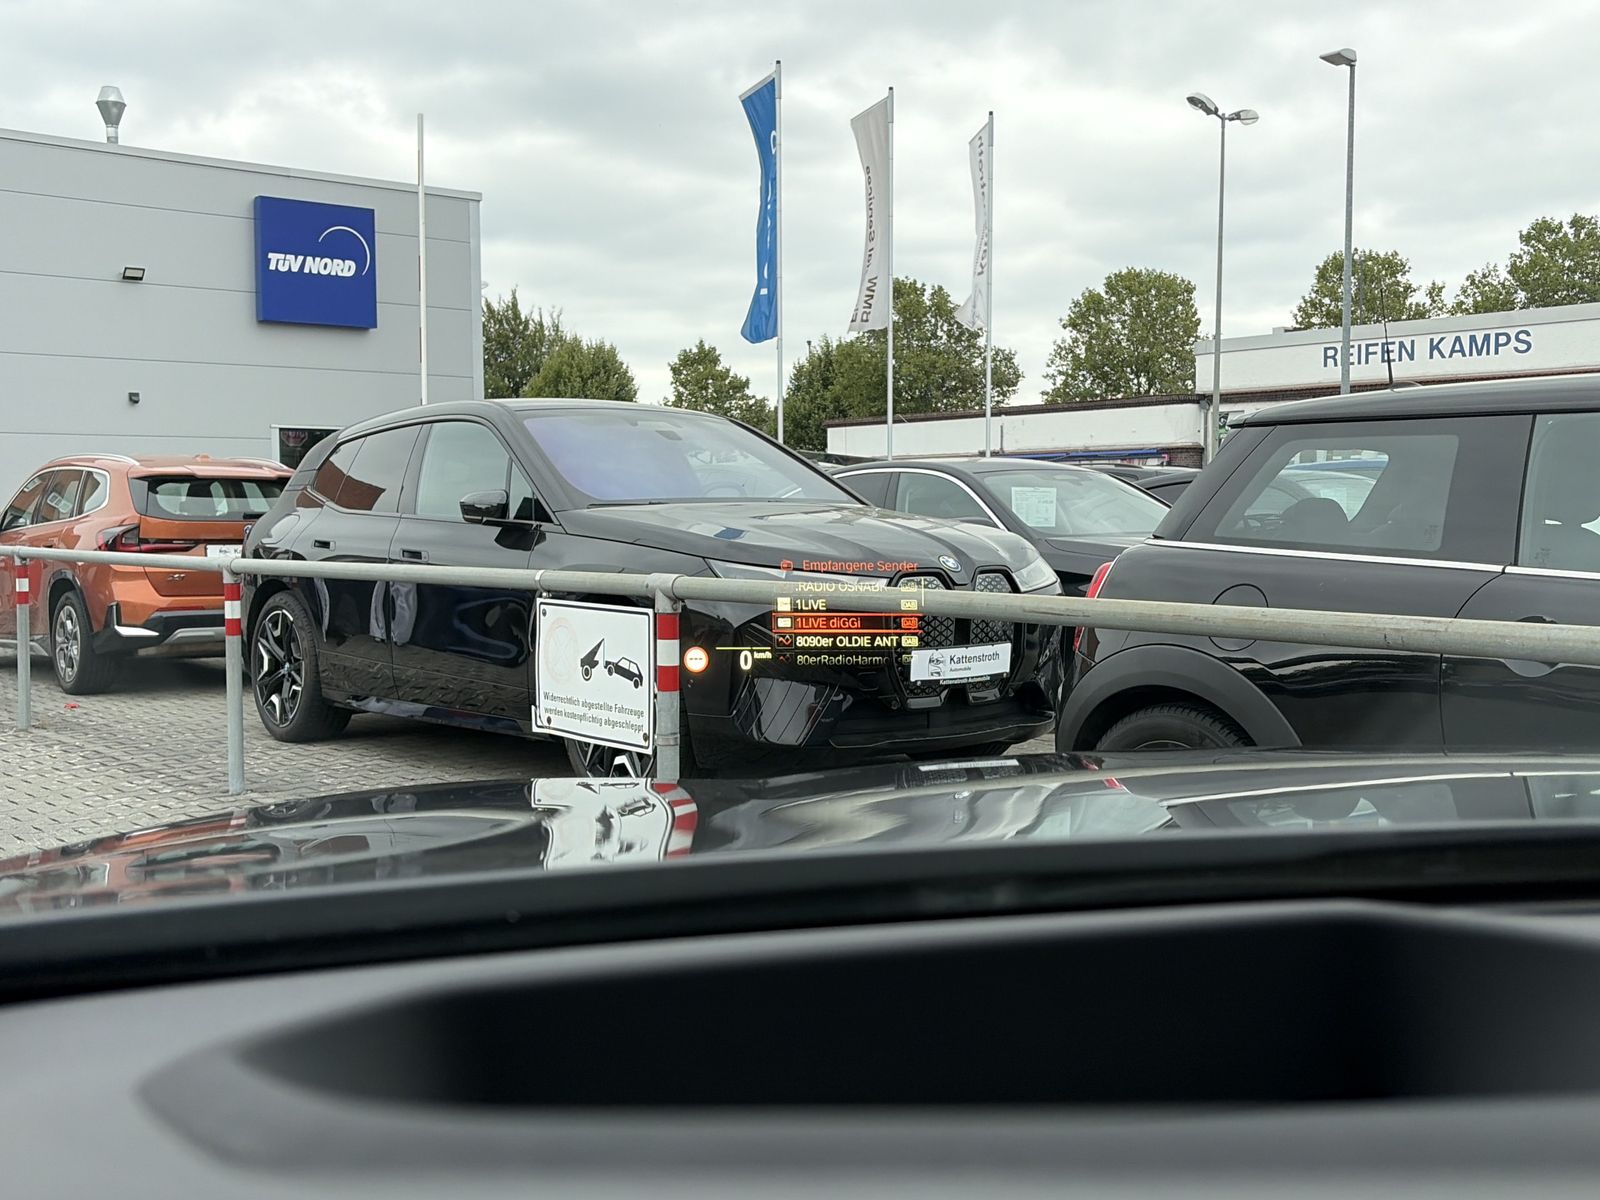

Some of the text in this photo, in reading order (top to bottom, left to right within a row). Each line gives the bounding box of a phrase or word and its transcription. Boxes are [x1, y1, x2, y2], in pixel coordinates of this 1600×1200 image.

[267, 252, 356, 277] TÜV NORD
[1429, 329, 1533, 360] KAMPS
[802, 560, 919, 573] Empfangene Sender
[796, 599, 827, 610] 1LIVE
[796, 618, 827, 629] 1LIVE
[829, 617, 861, 629] diGGi
[796, 636, 834, 647] 8090er
[836, 636, 872, 647] OLDIE
[873, 636, 899, 647] ANT
[740, 650, 772, 670] 0 km/h
[949, 651, 1000, 665] Kattenstroth
[543, 691, 644, 719] Widerrechtlich abgestellte Fahrzeuge
[544, 707, 644, 733] werden kostenpflichtig abgeschleppt
